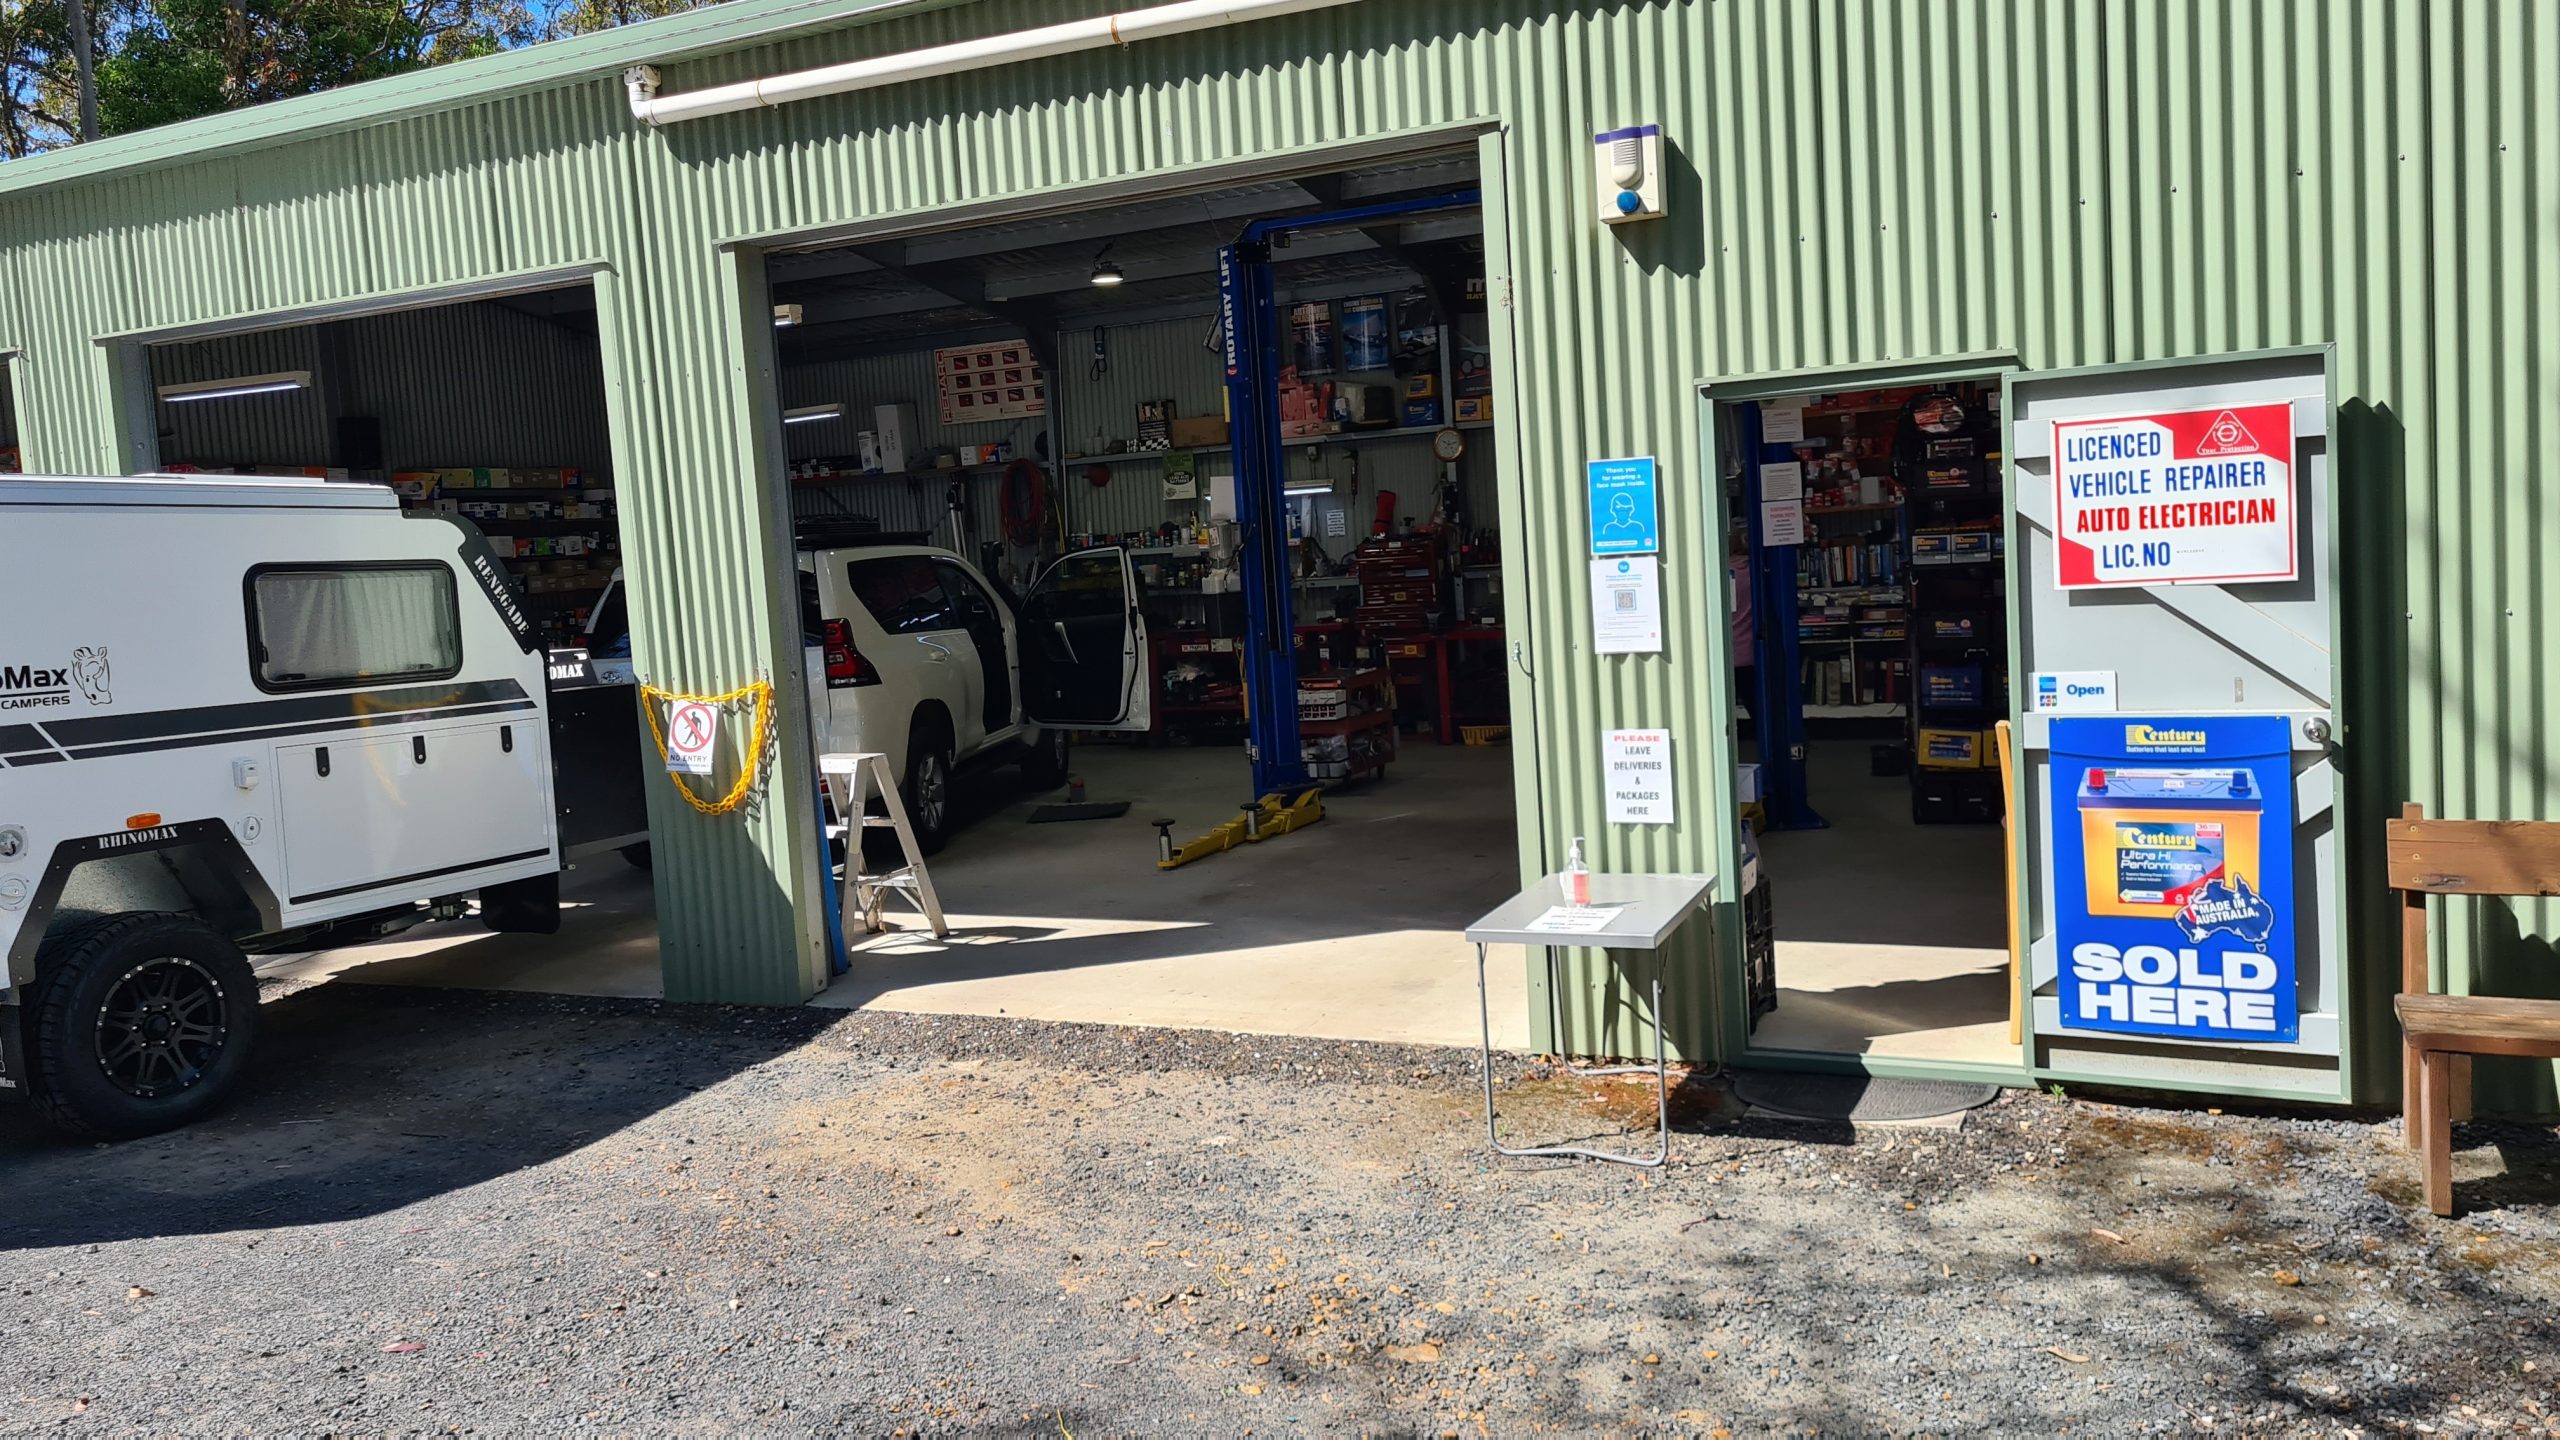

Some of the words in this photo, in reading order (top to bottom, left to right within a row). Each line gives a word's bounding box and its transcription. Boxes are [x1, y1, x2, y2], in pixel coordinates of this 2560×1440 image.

[1220, 249, 1231, 287] LIFT
[1223, 293, 1236, 366] ROTARY
[2068, 432, 2161, 462] LICENCED
[2070, 469, 2151, 498] VEHICLE
[2165, 461, 2266, 492] REPAIRER
[2077, 507, 2130, 533] AUTO
[2139, 498, 2276, 530] ELECTRICIAN
[474, 554, 530, 635] RENEGADE
[0, 665, 69, 689] Max
[2066, 684, 2105, 698] Open
[1, 696, 70, 710] CAMPERS
[2133, 725, 2206, 746] Century
[1625, 746, 1651, 755] LEAVE
[1614, 761, 1662, 770] DELIVERIES
[1635, 776, 1641, 785] &
[1616, 791, 1660, 800] PACKAGES
[1626, 806, 1649, 815] HERE
[98, 826, 179, 849] RHINOMAX
[2122, 827, 2196, 850] Century
[2121, 850, 2156, 860] Ultra
[2158, 851, 2171, 860] Hi
[2121, 859, 2202, 870] Performance
[2199, 900, 2231, 914] MADE
[2233, 898, 2246, 909] IN
[2072, 942, 2278, 991] SOLD
[2079, 982, 2277, 1031] HERE
